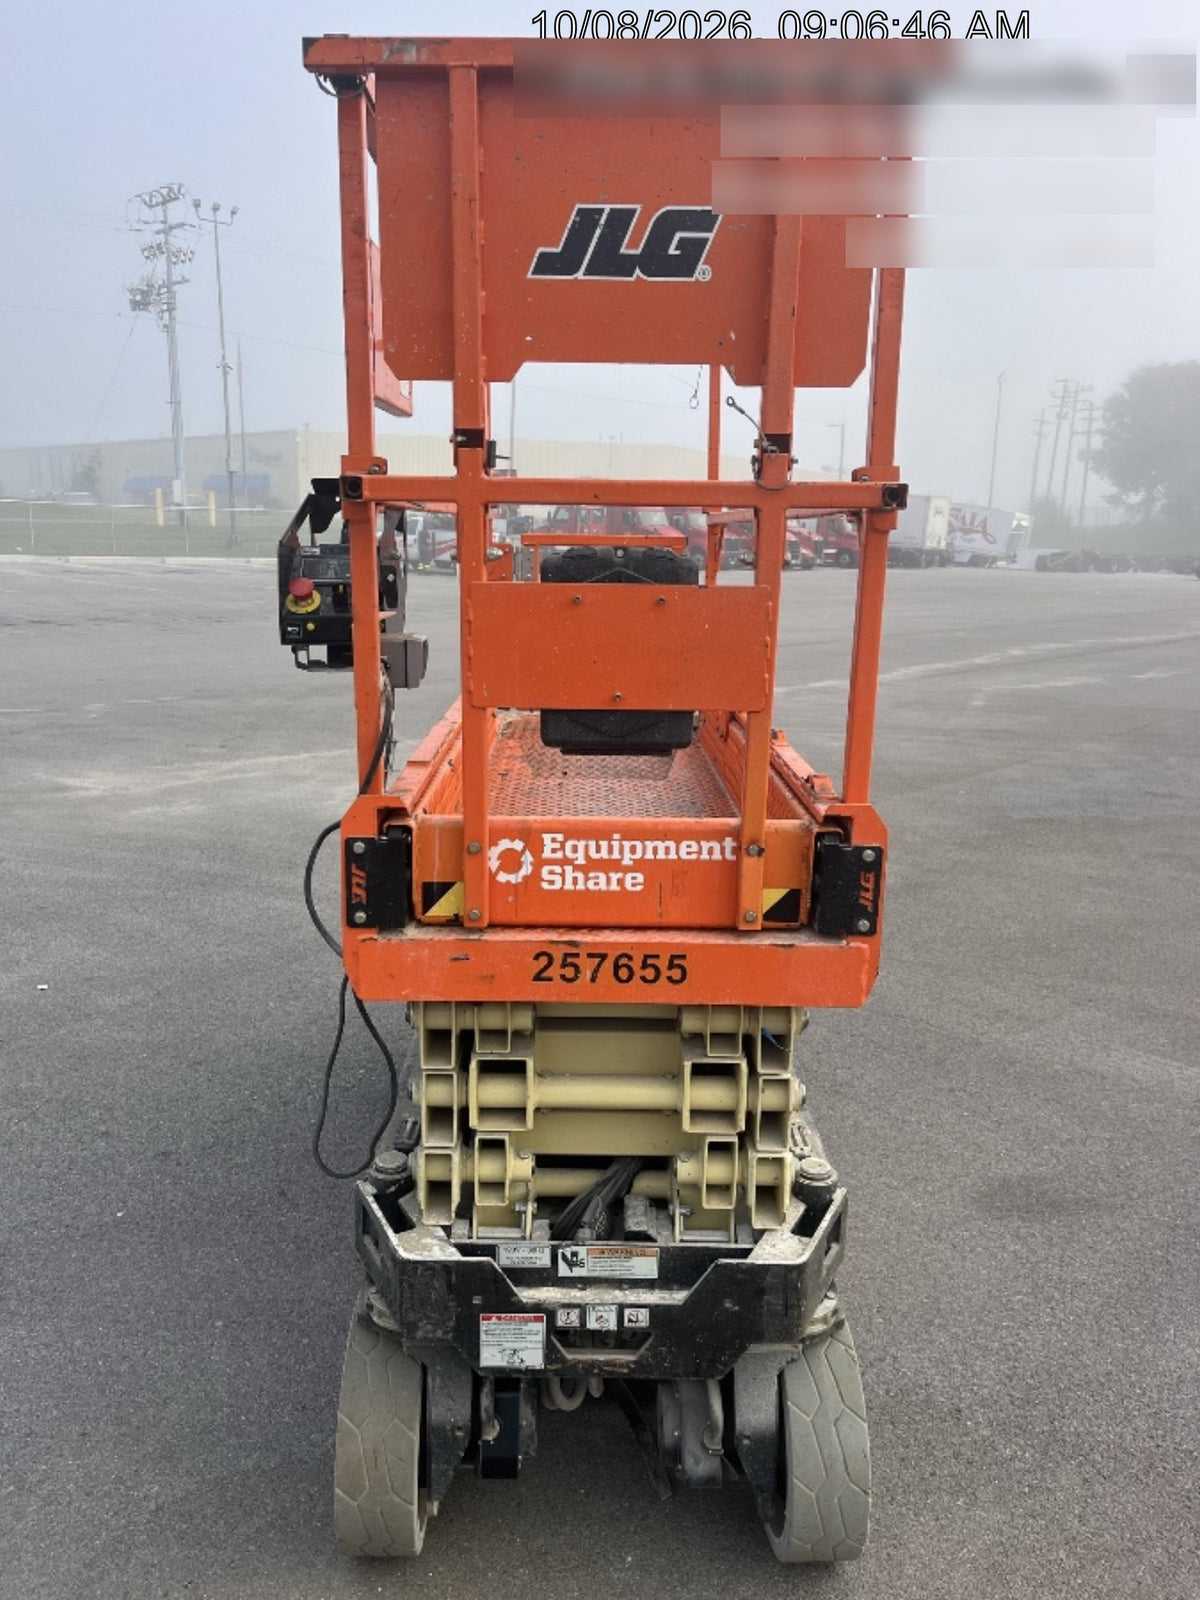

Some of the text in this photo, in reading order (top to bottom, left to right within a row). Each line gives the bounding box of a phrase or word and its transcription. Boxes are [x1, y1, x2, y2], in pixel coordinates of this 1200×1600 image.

[526, 203, 723, 281] JLG
[541, 833, 738, 865] Equipment
[540, 865, 645, 891] Share
[859, 870, 875, 913] JLG
[531, 950, 688, 985] 257655
